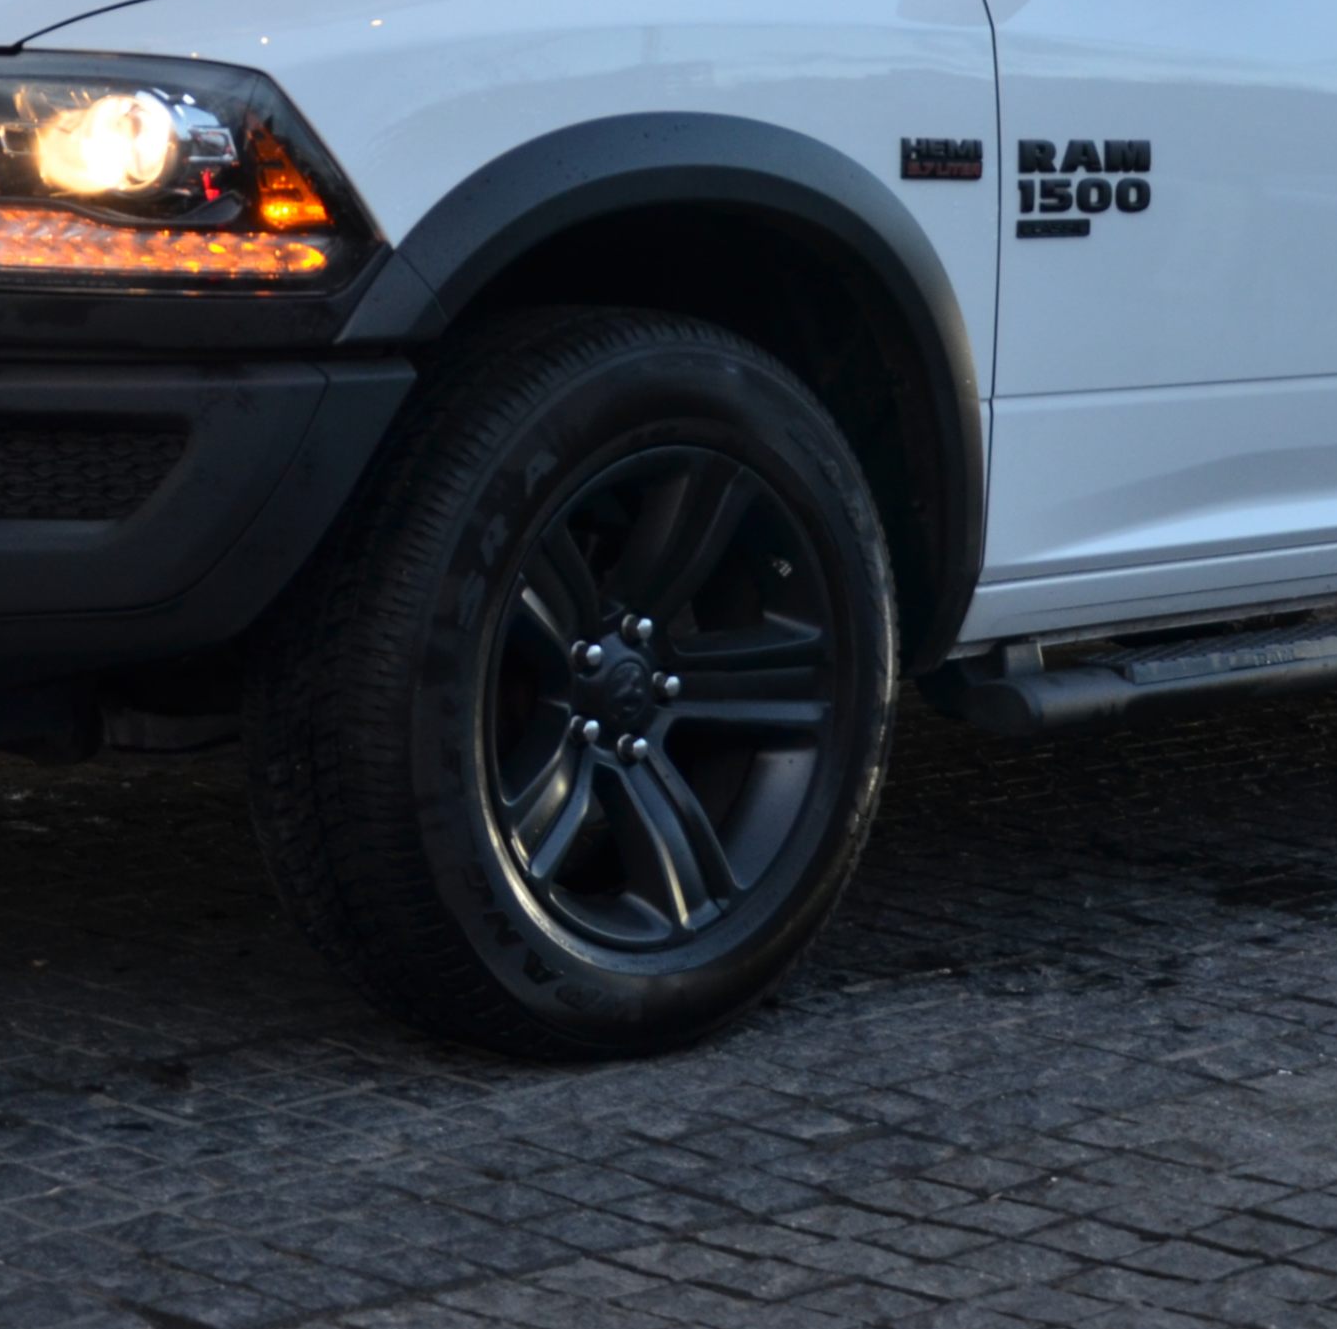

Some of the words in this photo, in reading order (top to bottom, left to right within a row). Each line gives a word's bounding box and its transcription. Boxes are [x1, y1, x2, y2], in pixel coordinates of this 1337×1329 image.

[900, 136, 982, 160] HEMI
[1018, 138, 1151, 173] RAM
[1017, 177, 1152, 214] 1500
